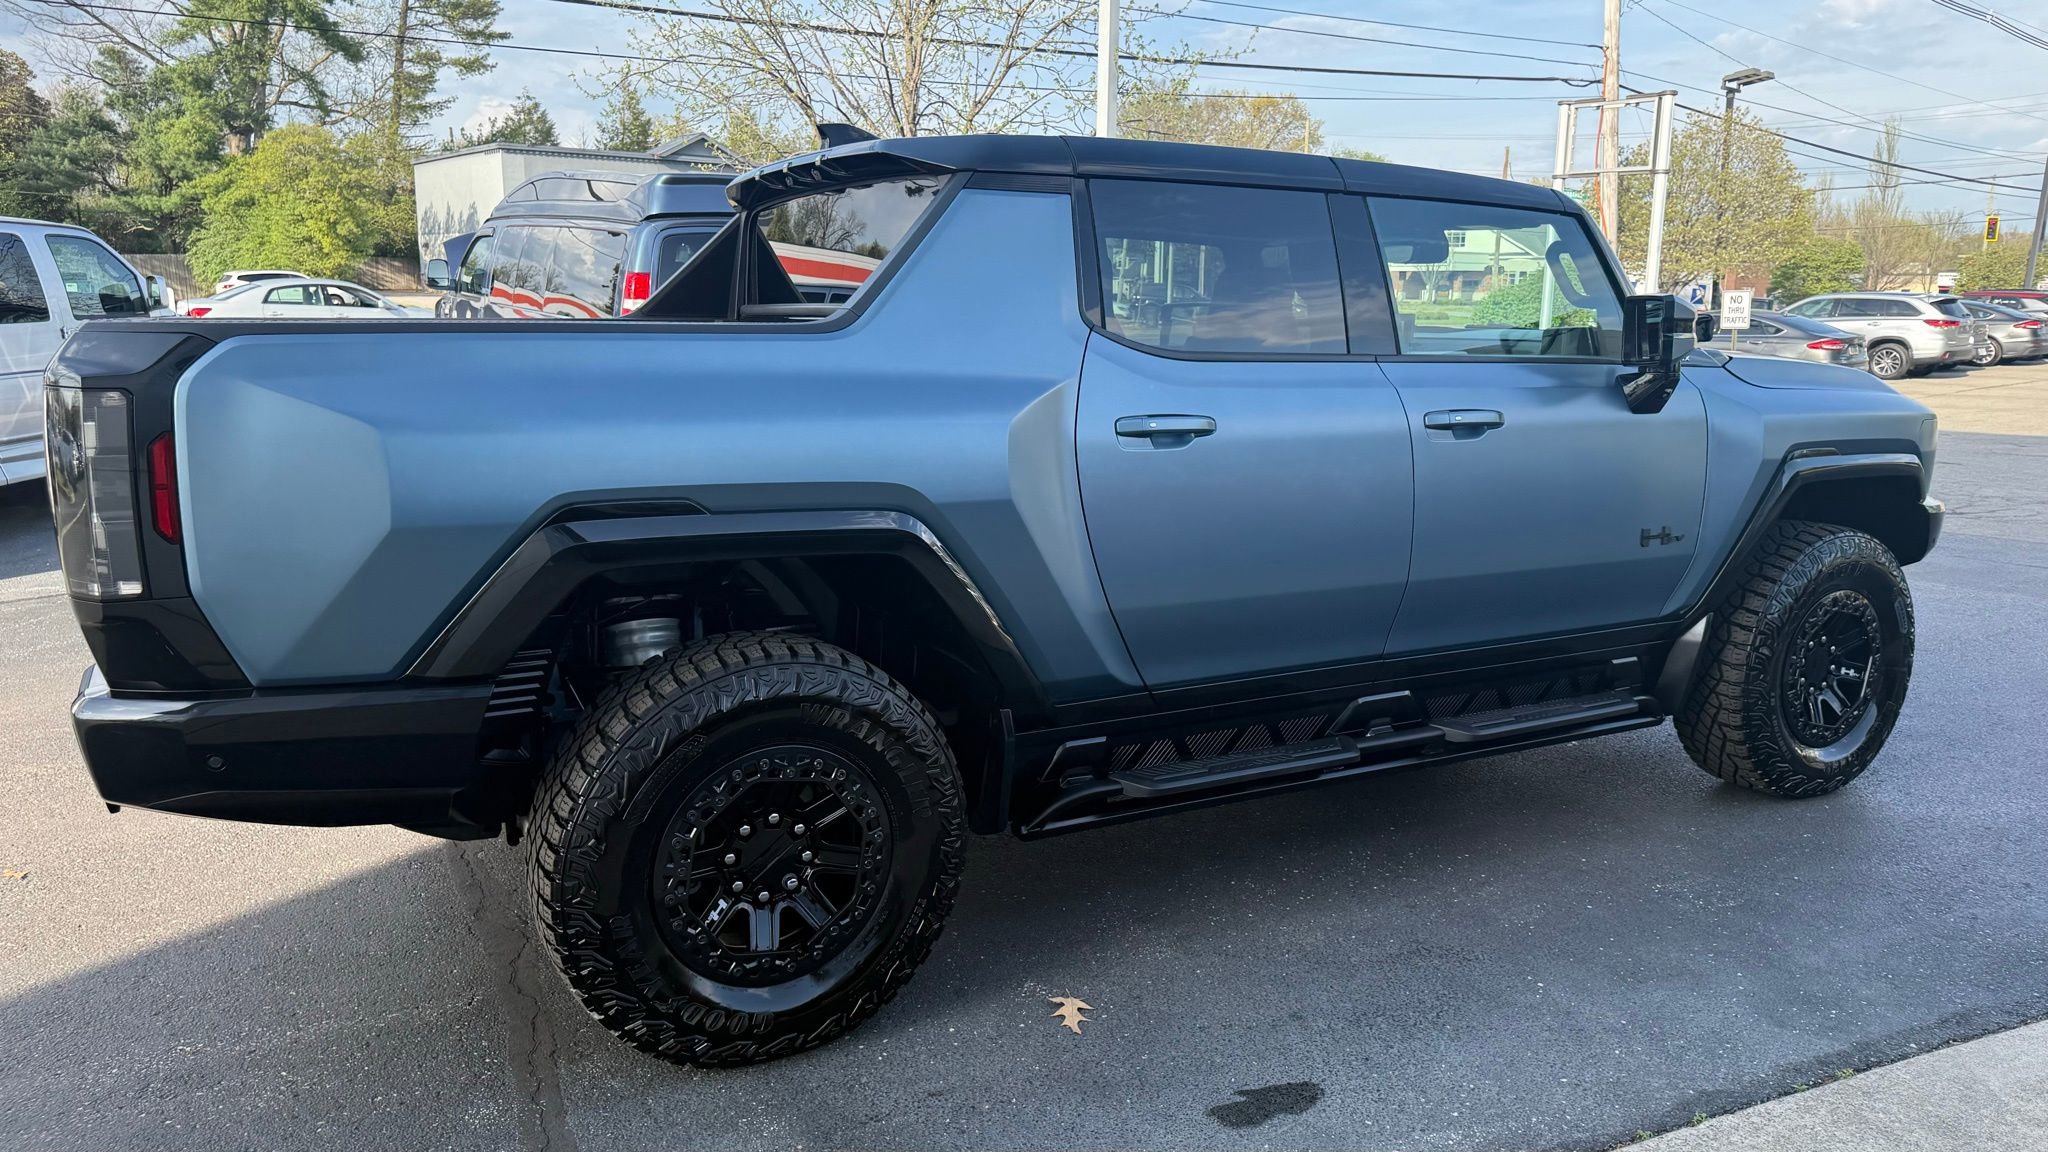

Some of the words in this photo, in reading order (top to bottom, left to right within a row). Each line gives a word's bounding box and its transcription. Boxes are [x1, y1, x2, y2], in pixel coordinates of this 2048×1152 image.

[1729, 295, 1743, 305] NO
[1728, 306, 1745, 314] THRU
[1724, 316, 1747, 325] TRAFFIC
[800, 702, 933, 818] WRANGLER
